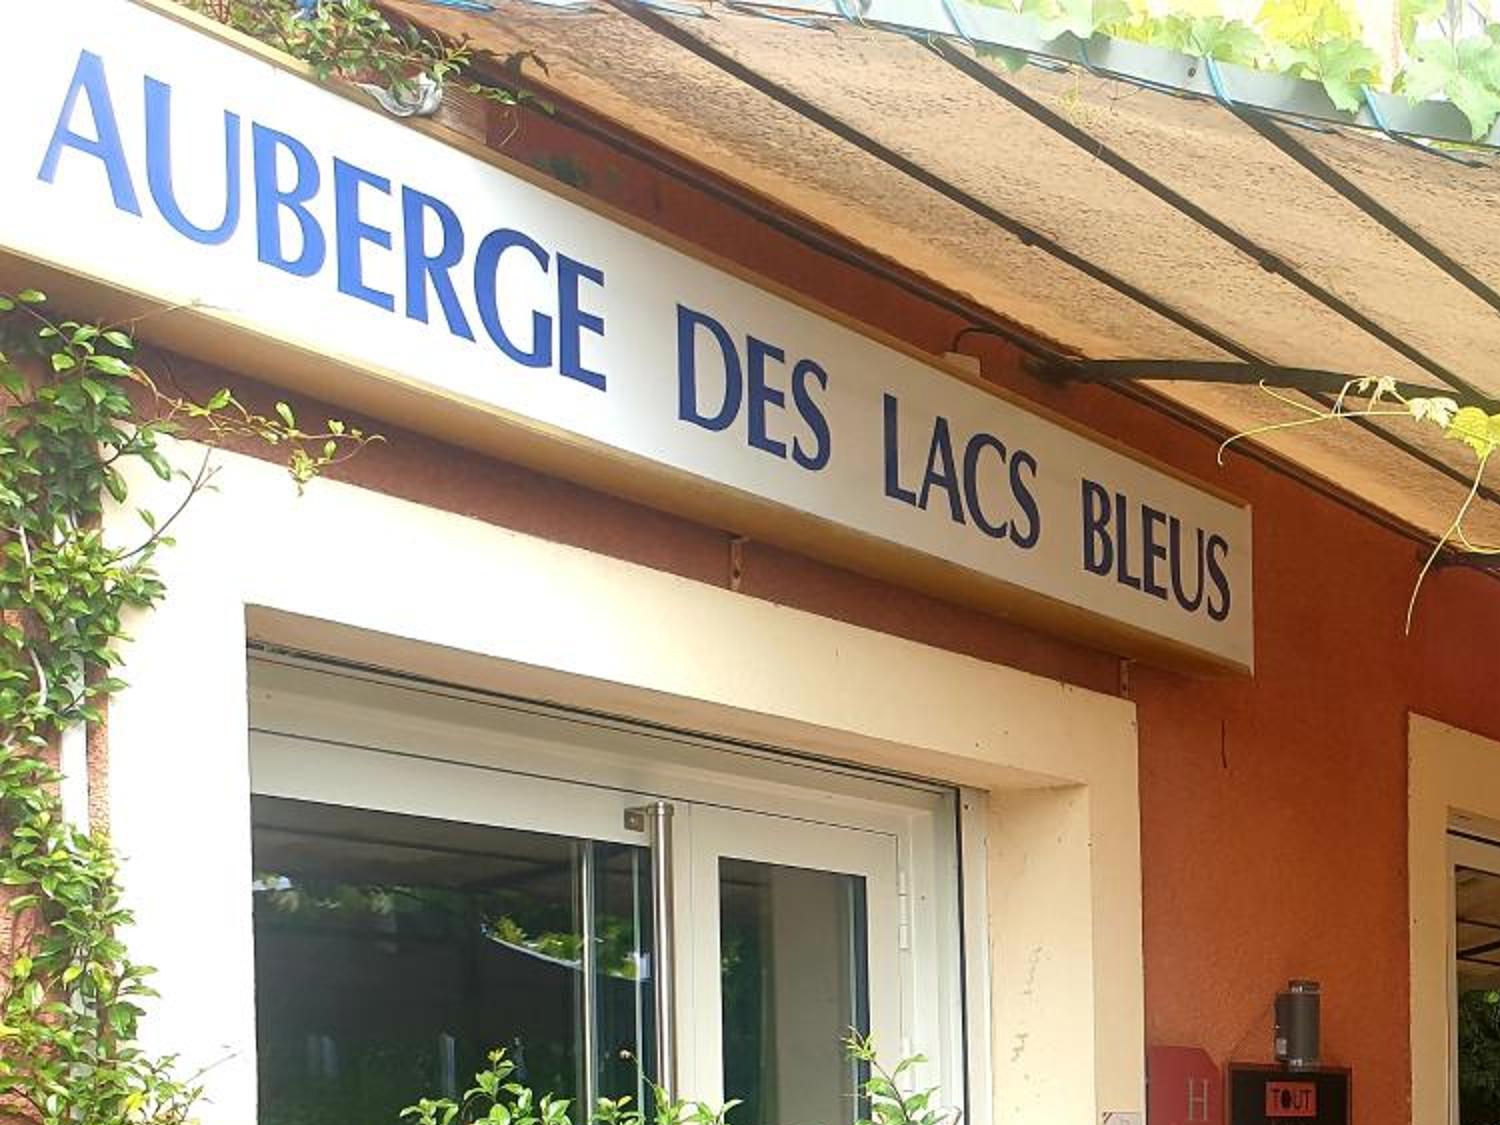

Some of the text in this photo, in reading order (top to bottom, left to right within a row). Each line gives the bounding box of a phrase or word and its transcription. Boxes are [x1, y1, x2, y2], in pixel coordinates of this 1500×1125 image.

[37, 48, 1231, 623] AUBERGE DES LACS BLEUS
[1187, 1079, 1209, 1122] H
[1271, 1088, 1313, 1110] TOUT
